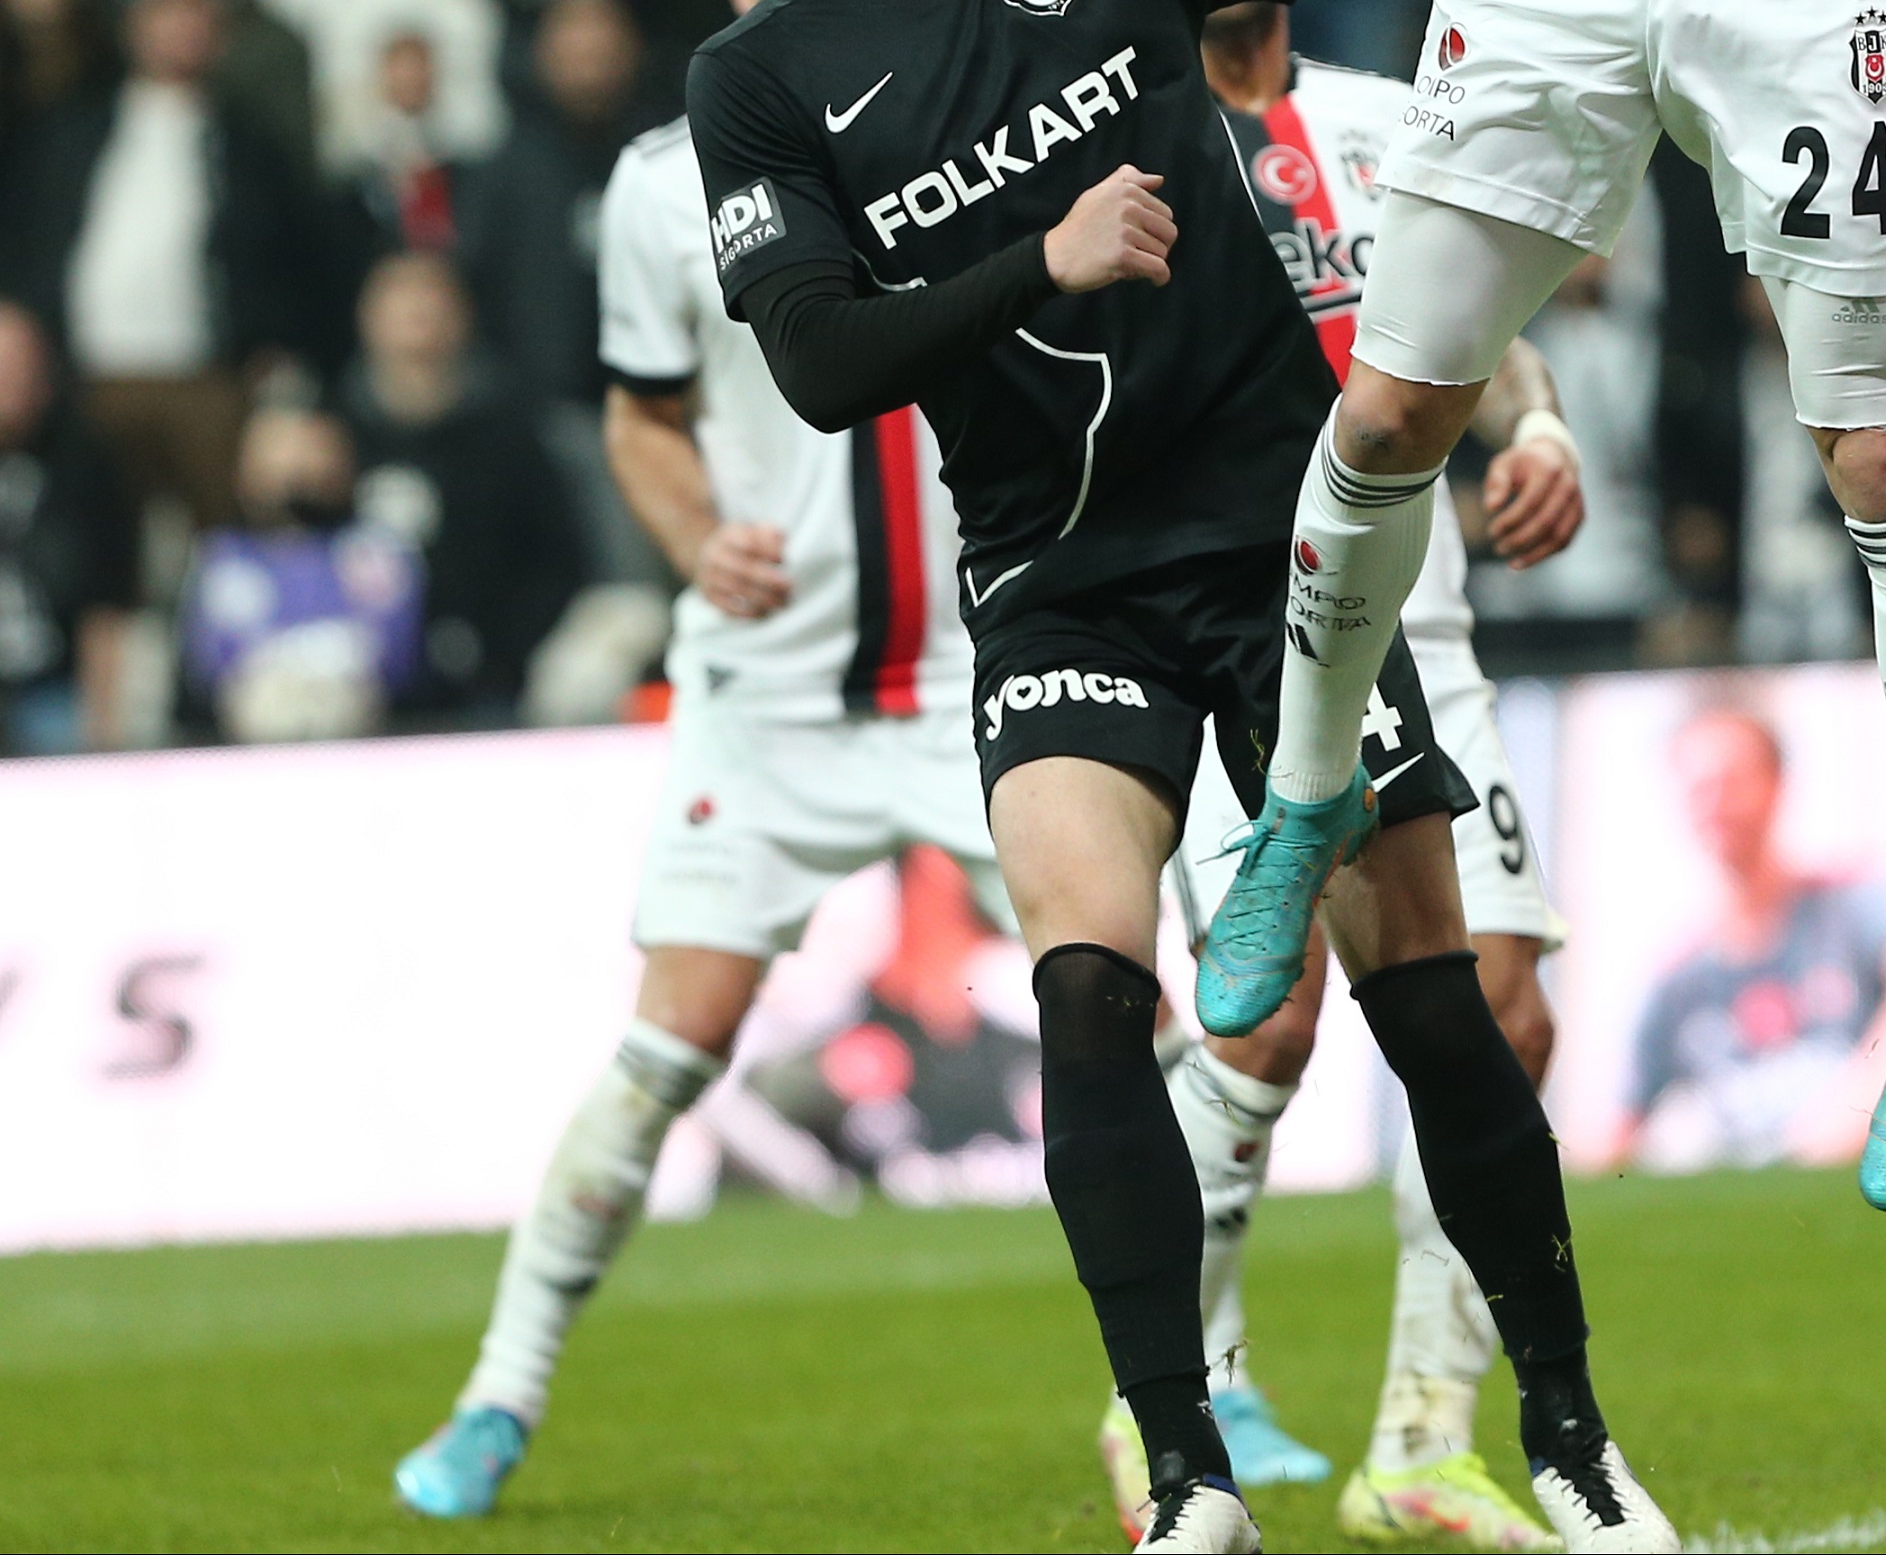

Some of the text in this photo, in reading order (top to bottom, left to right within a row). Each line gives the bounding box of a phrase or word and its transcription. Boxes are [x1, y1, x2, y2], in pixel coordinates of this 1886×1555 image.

[863, 45, 1139, 250] FOLKART
[711, 183, 773, 255] HDI
[719, 223, 778, 271] SIGORTA
[1268, 219, 1375, 284] eko
[982, 667, 1150, 742] yonca
